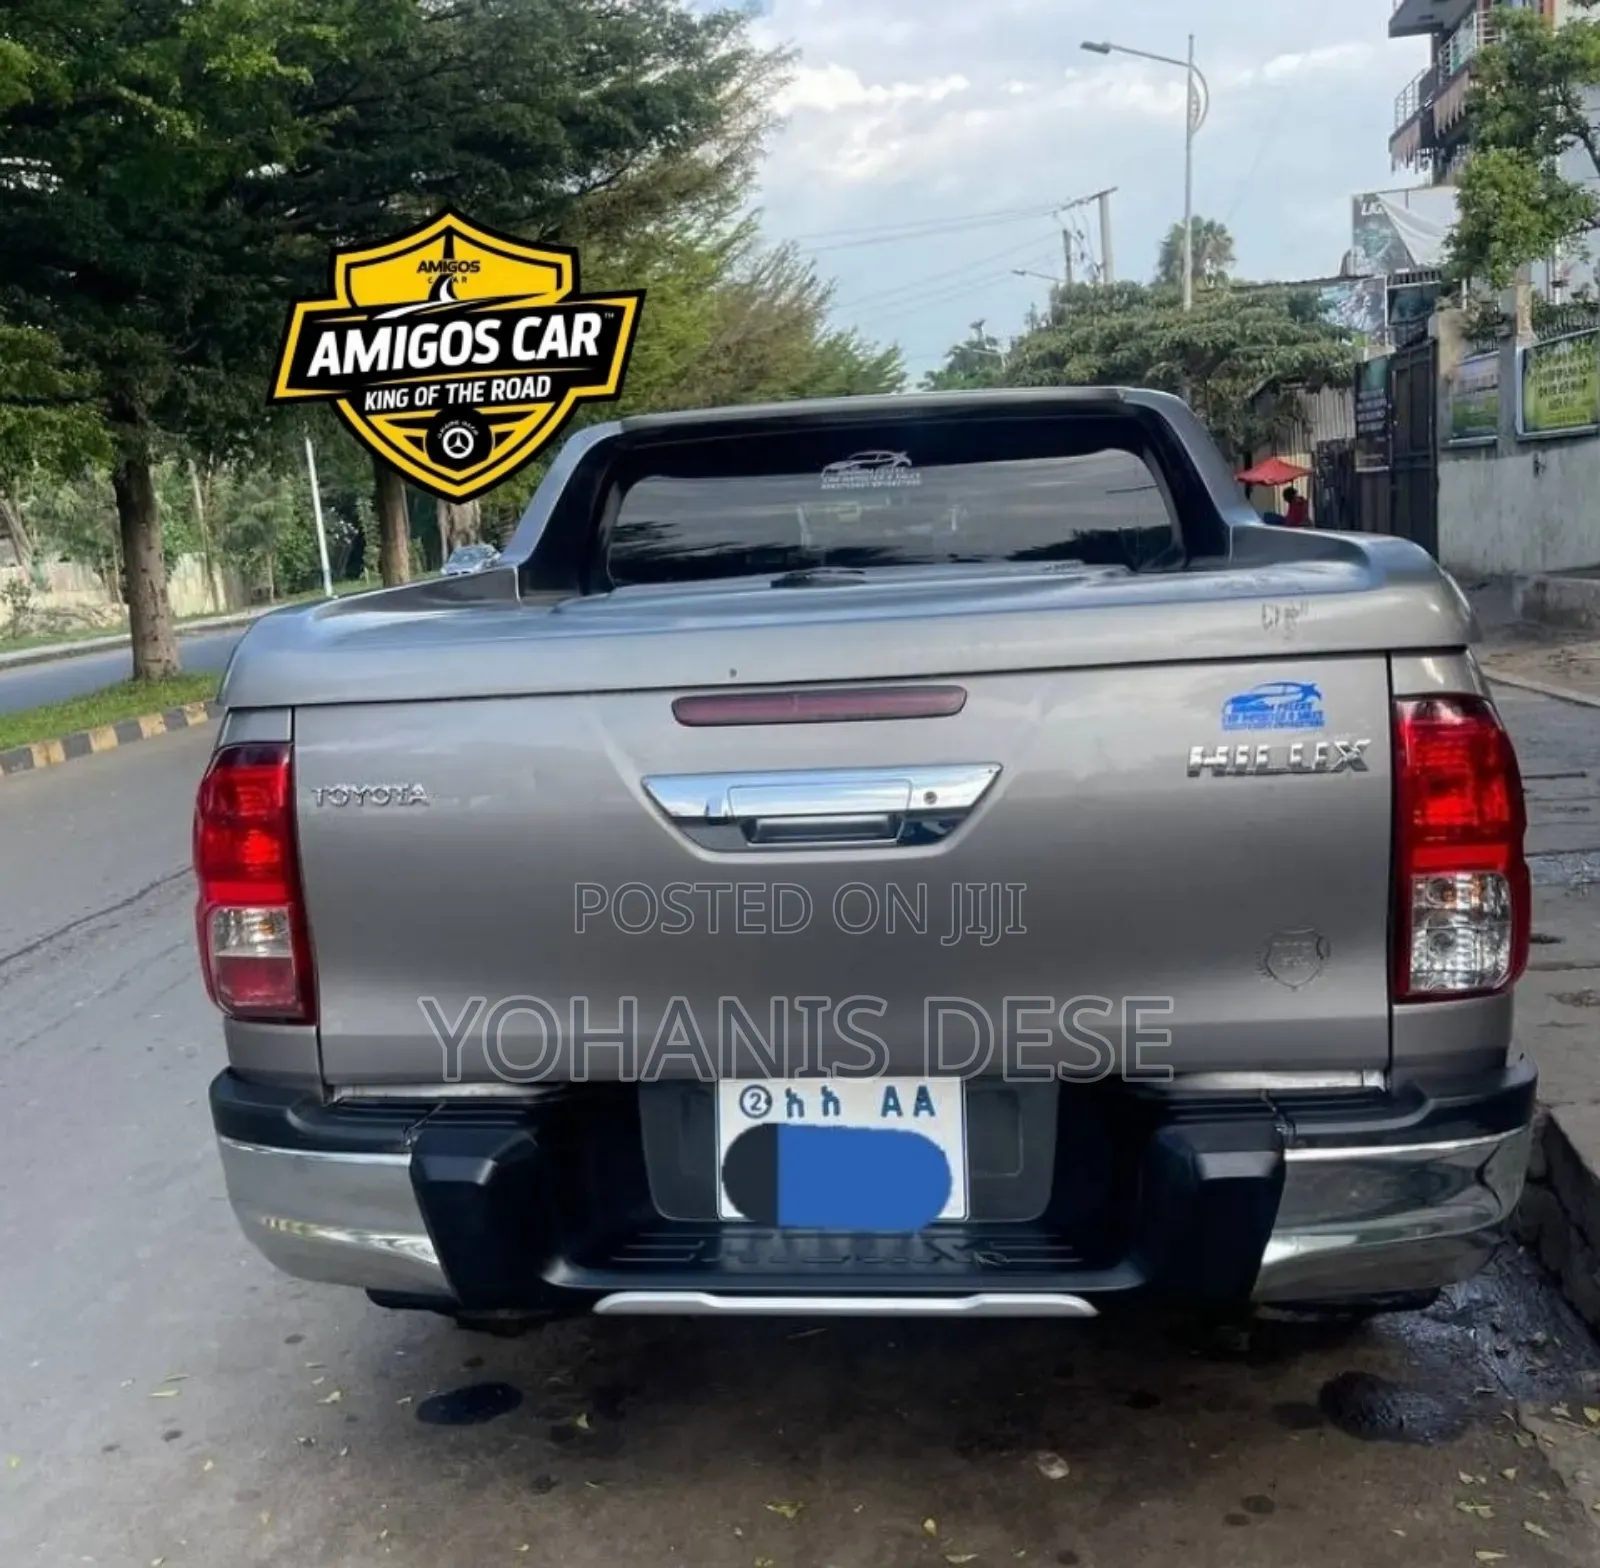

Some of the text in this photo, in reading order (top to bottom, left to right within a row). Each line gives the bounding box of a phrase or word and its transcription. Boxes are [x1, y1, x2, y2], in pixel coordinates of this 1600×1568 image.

[1187, 738, 1371, 778] HILUX
[311, 782, 431, 807] TOYOTA
[881, 1085, 936, 1118] AA
